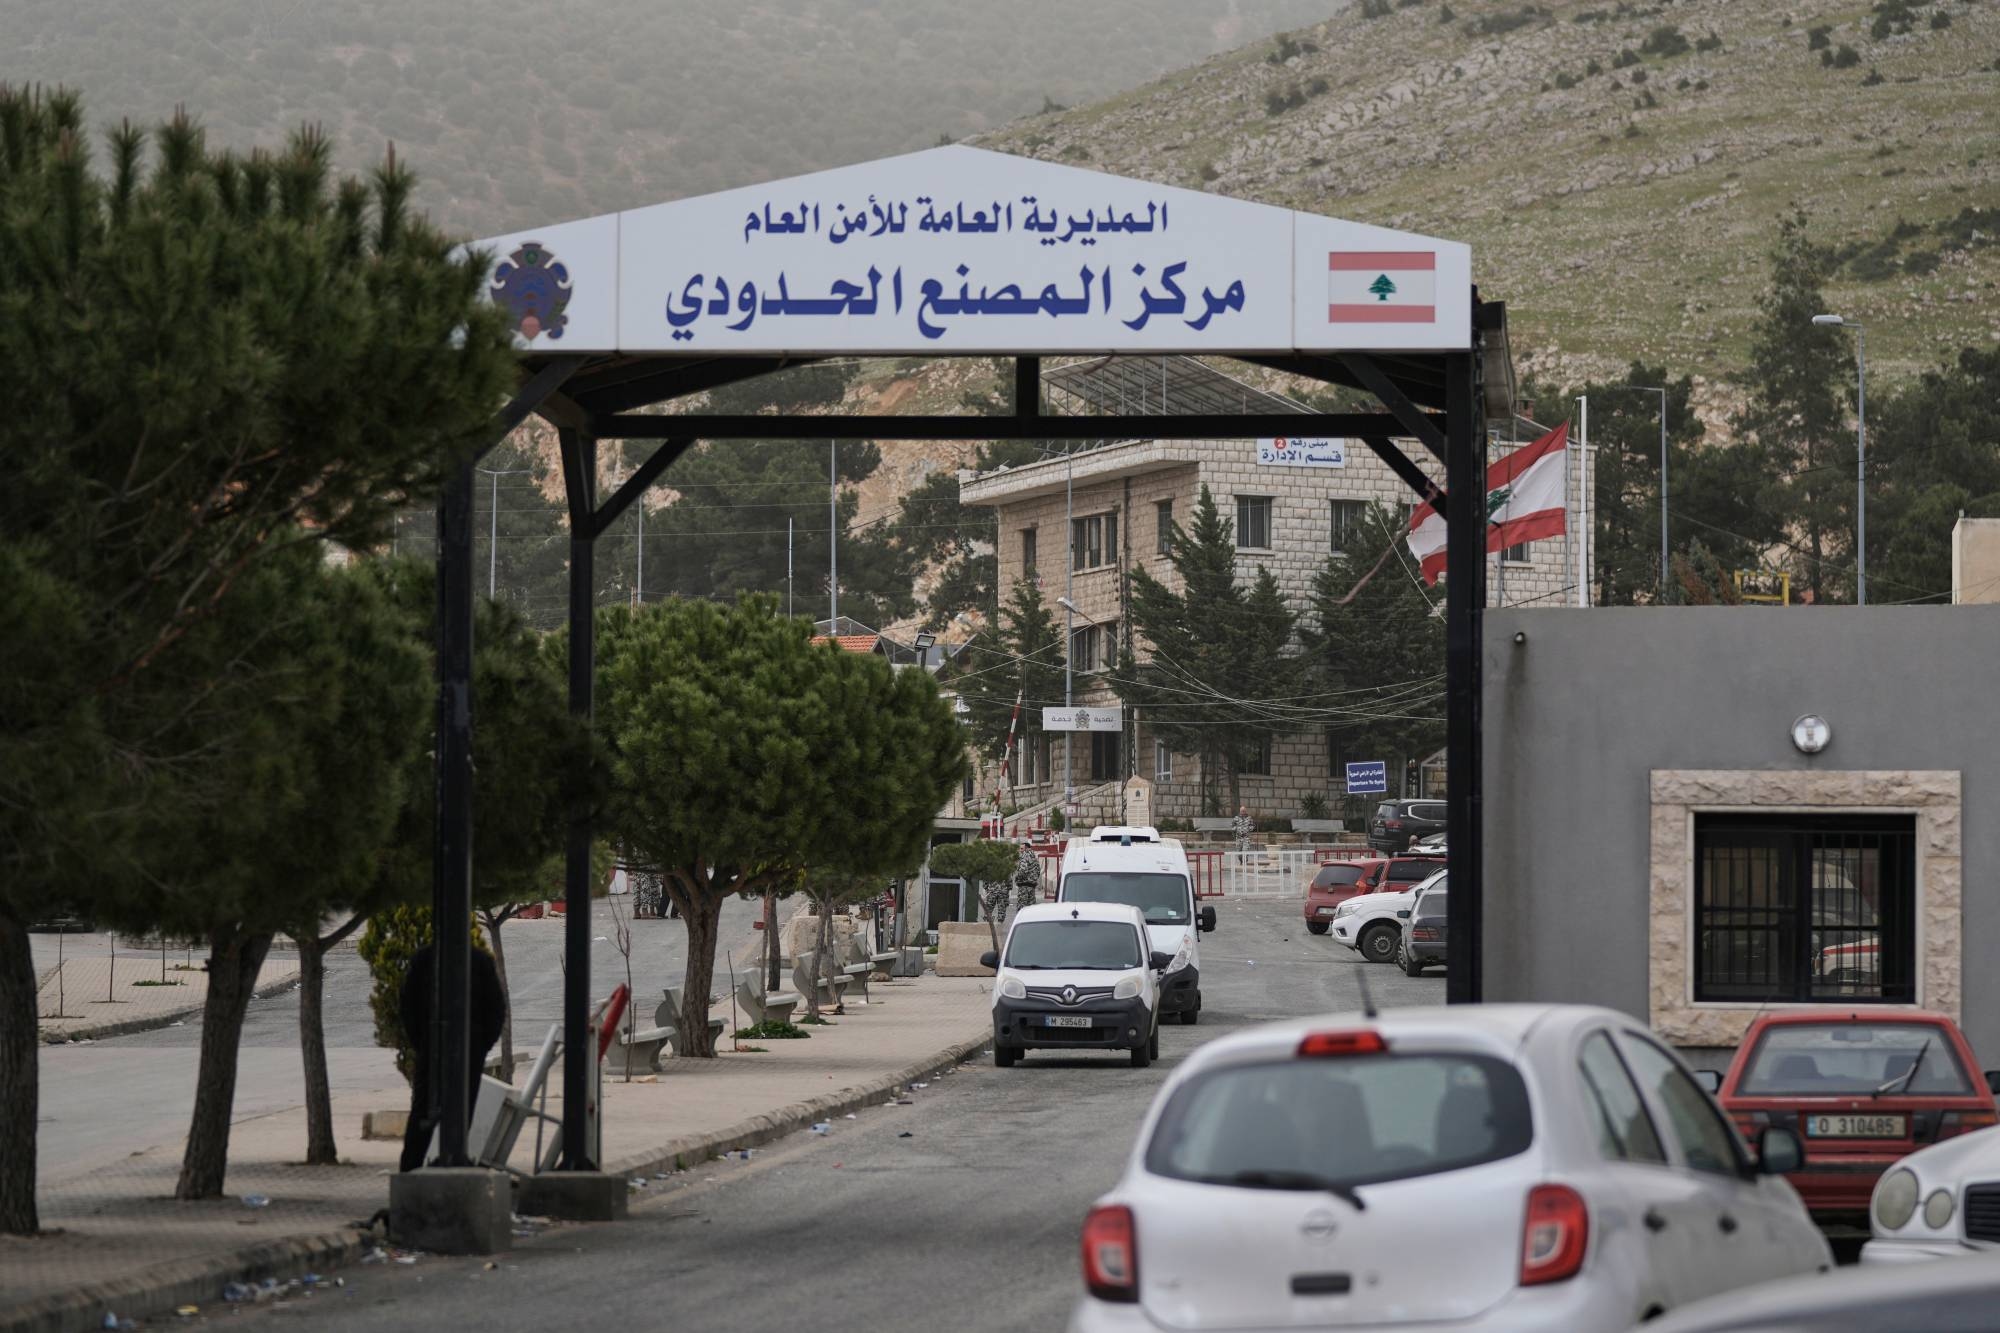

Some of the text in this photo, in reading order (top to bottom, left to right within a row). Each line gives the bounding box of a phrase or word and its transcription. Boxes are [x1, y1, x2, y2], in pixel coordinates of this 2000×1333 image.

[743, 193, 1168, 247] المديرية العامة للأمن العام
[665, 260, 1246, 342] مركز المصنع الحدودي
[1262, 448, 1342, 464] قسم الإدارة
[1838, 1117, 1895, 1134] 310485
